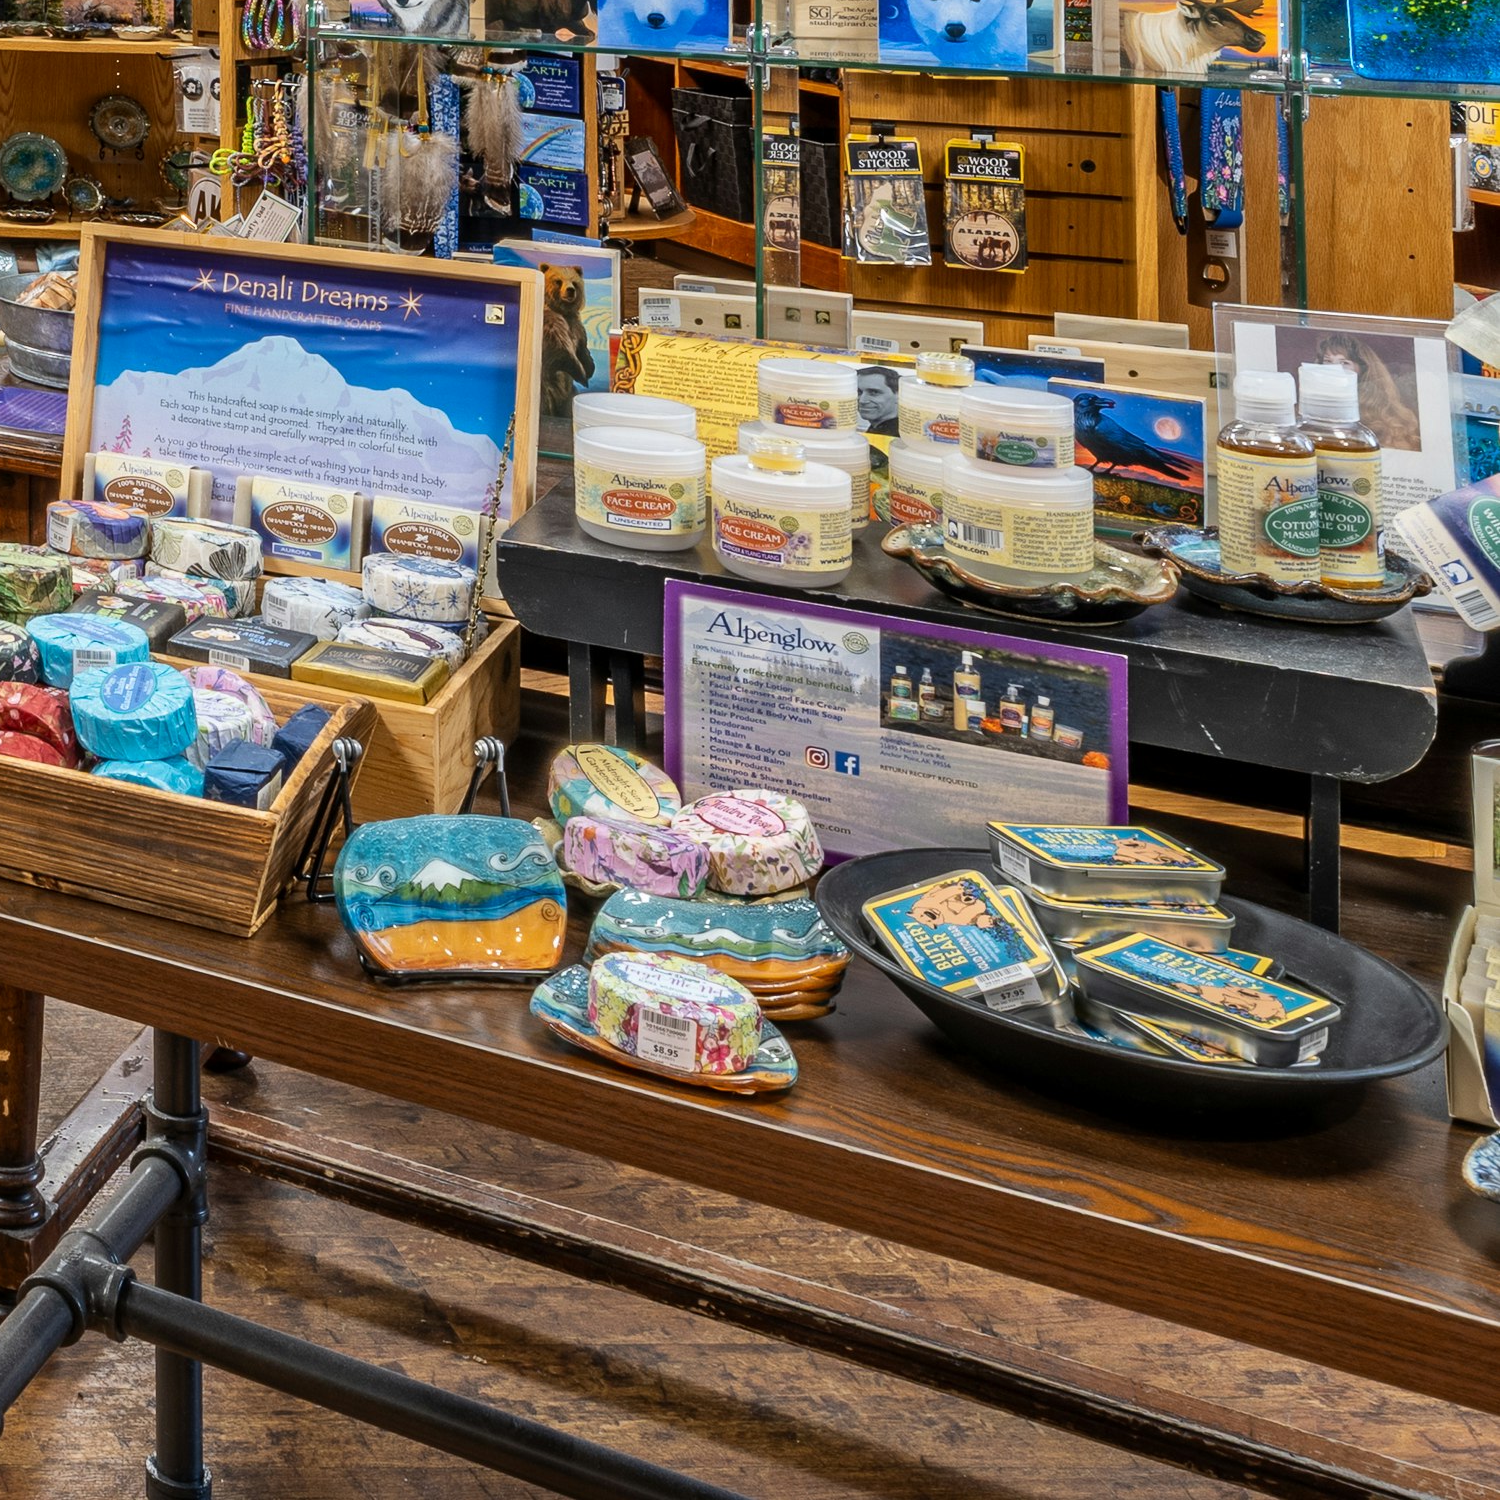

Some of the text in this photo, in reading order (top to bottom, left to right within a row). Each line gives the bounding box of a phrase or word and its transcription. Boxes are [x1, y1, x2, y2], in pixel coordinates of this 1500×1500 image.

[868, 150, 906, 160] WOOD
[528, 176, 576, 190] EARTH
[958, 228, 1010, 238] ALASKA
[222, 272, 389, 312] Denali Dreams
[224, 303, 383, 332] FINE HANDCRAFTED SOAPS
[188, 391, 408, 432] This handcrafted soap is made simply and naturally.
[160, 399, 438, 448] Each soap is hand cut and groomed. They are then finished with
[610, 472, 667, 490] Alpenglow
[277, 485, 325, 502] Alpenglow
[276, 504, 325, 521] 100% NATURAL
[606, 496, 671, 512] FACE CREAM
[614, 517, 664, 528] UNSCENTED
[280, 546, 312, 558] AURORA
[237, 631, 291, 648] LAGER BEER
[706, 611, 837, 654] Alpenglow
[692, 657, 740, 674] Extremely
[743, 666, 783, 682] effective
[786, 672, 804, 684] and
[710, 671, 732, 682] Hand
[742, 676, 760, 690] Body
[762, 680, 794, 694] Lotion
[709, 717, 755, 732] Deodorant
[880, 764, 978, 790] RETURN RECEIPT REQUESTED
[903, 921, 952, 971] BUTTERY
[934, 931, 968, 968] BEAR
[1000, 988, 1026, 1000] $7.95
[654, 1044, 678, 1058] $8.95
